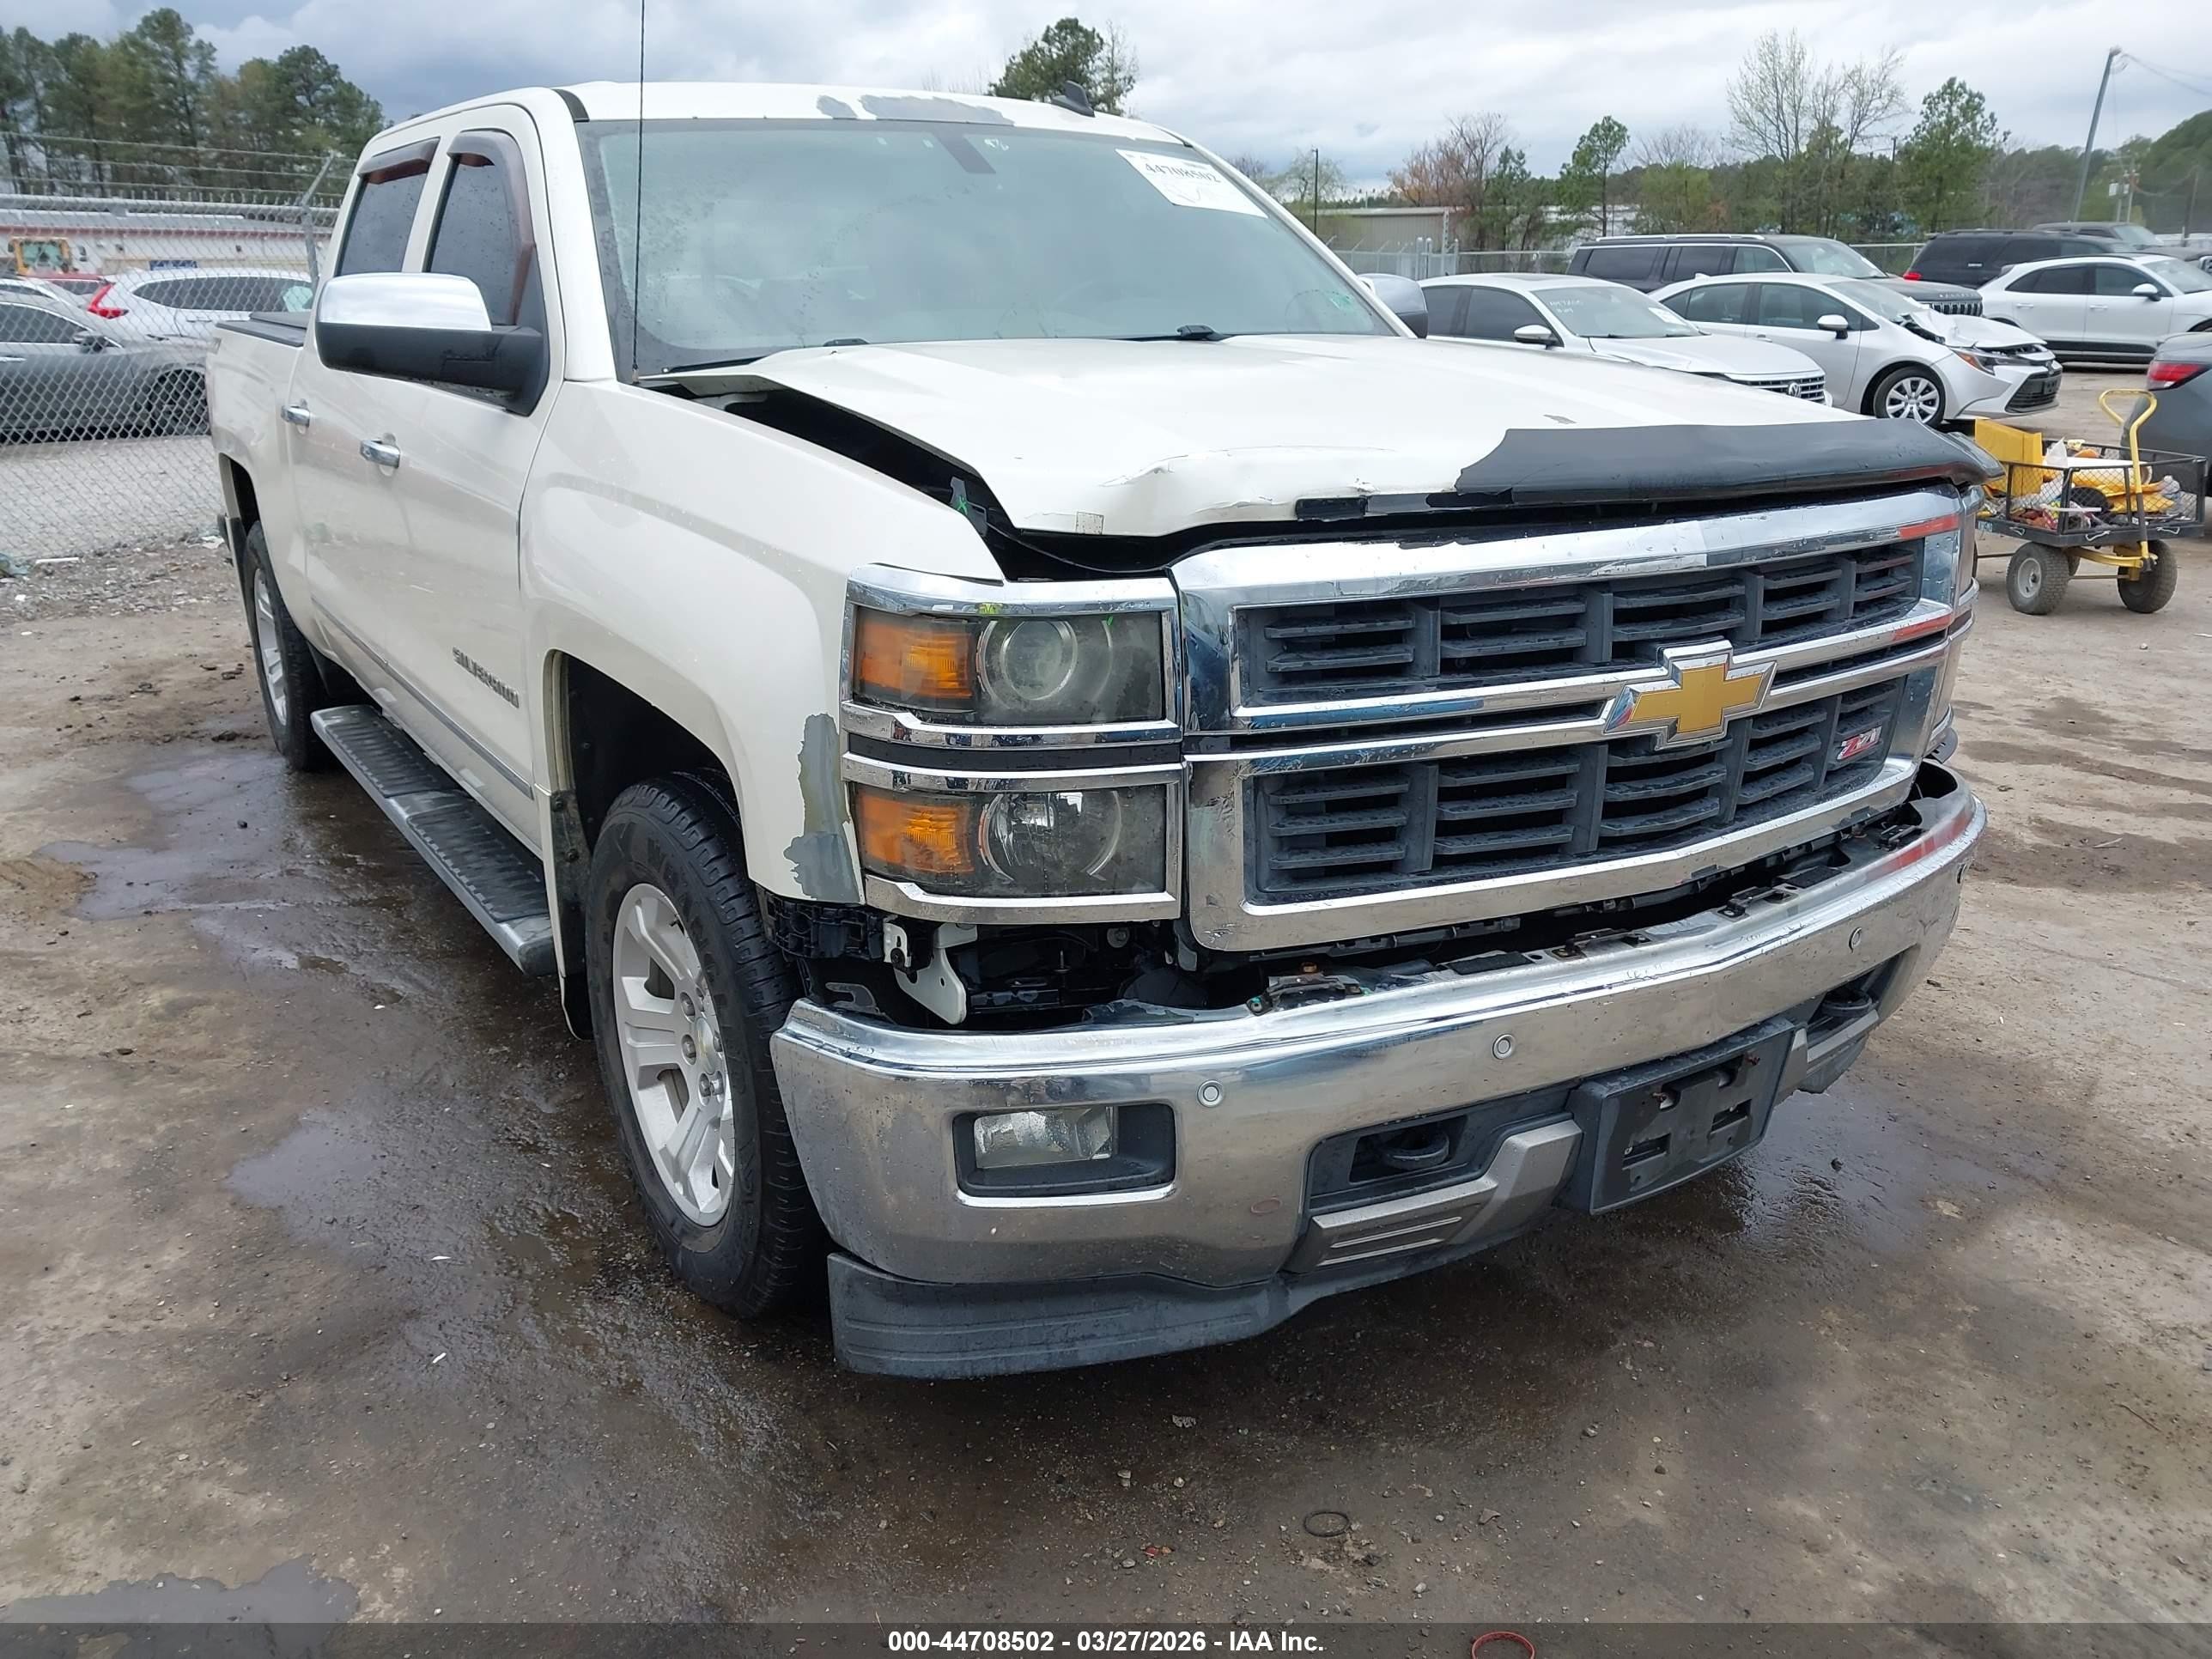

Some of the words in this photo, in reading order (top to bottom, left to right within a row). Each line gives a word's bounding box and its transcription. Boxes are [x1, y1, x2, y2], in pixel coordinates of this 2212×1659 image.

[1145, 163, 1222, 183] 44708502
[453, 647, 520, 708] SILVERADO
[1837, 726, 1882, 760] Z71
